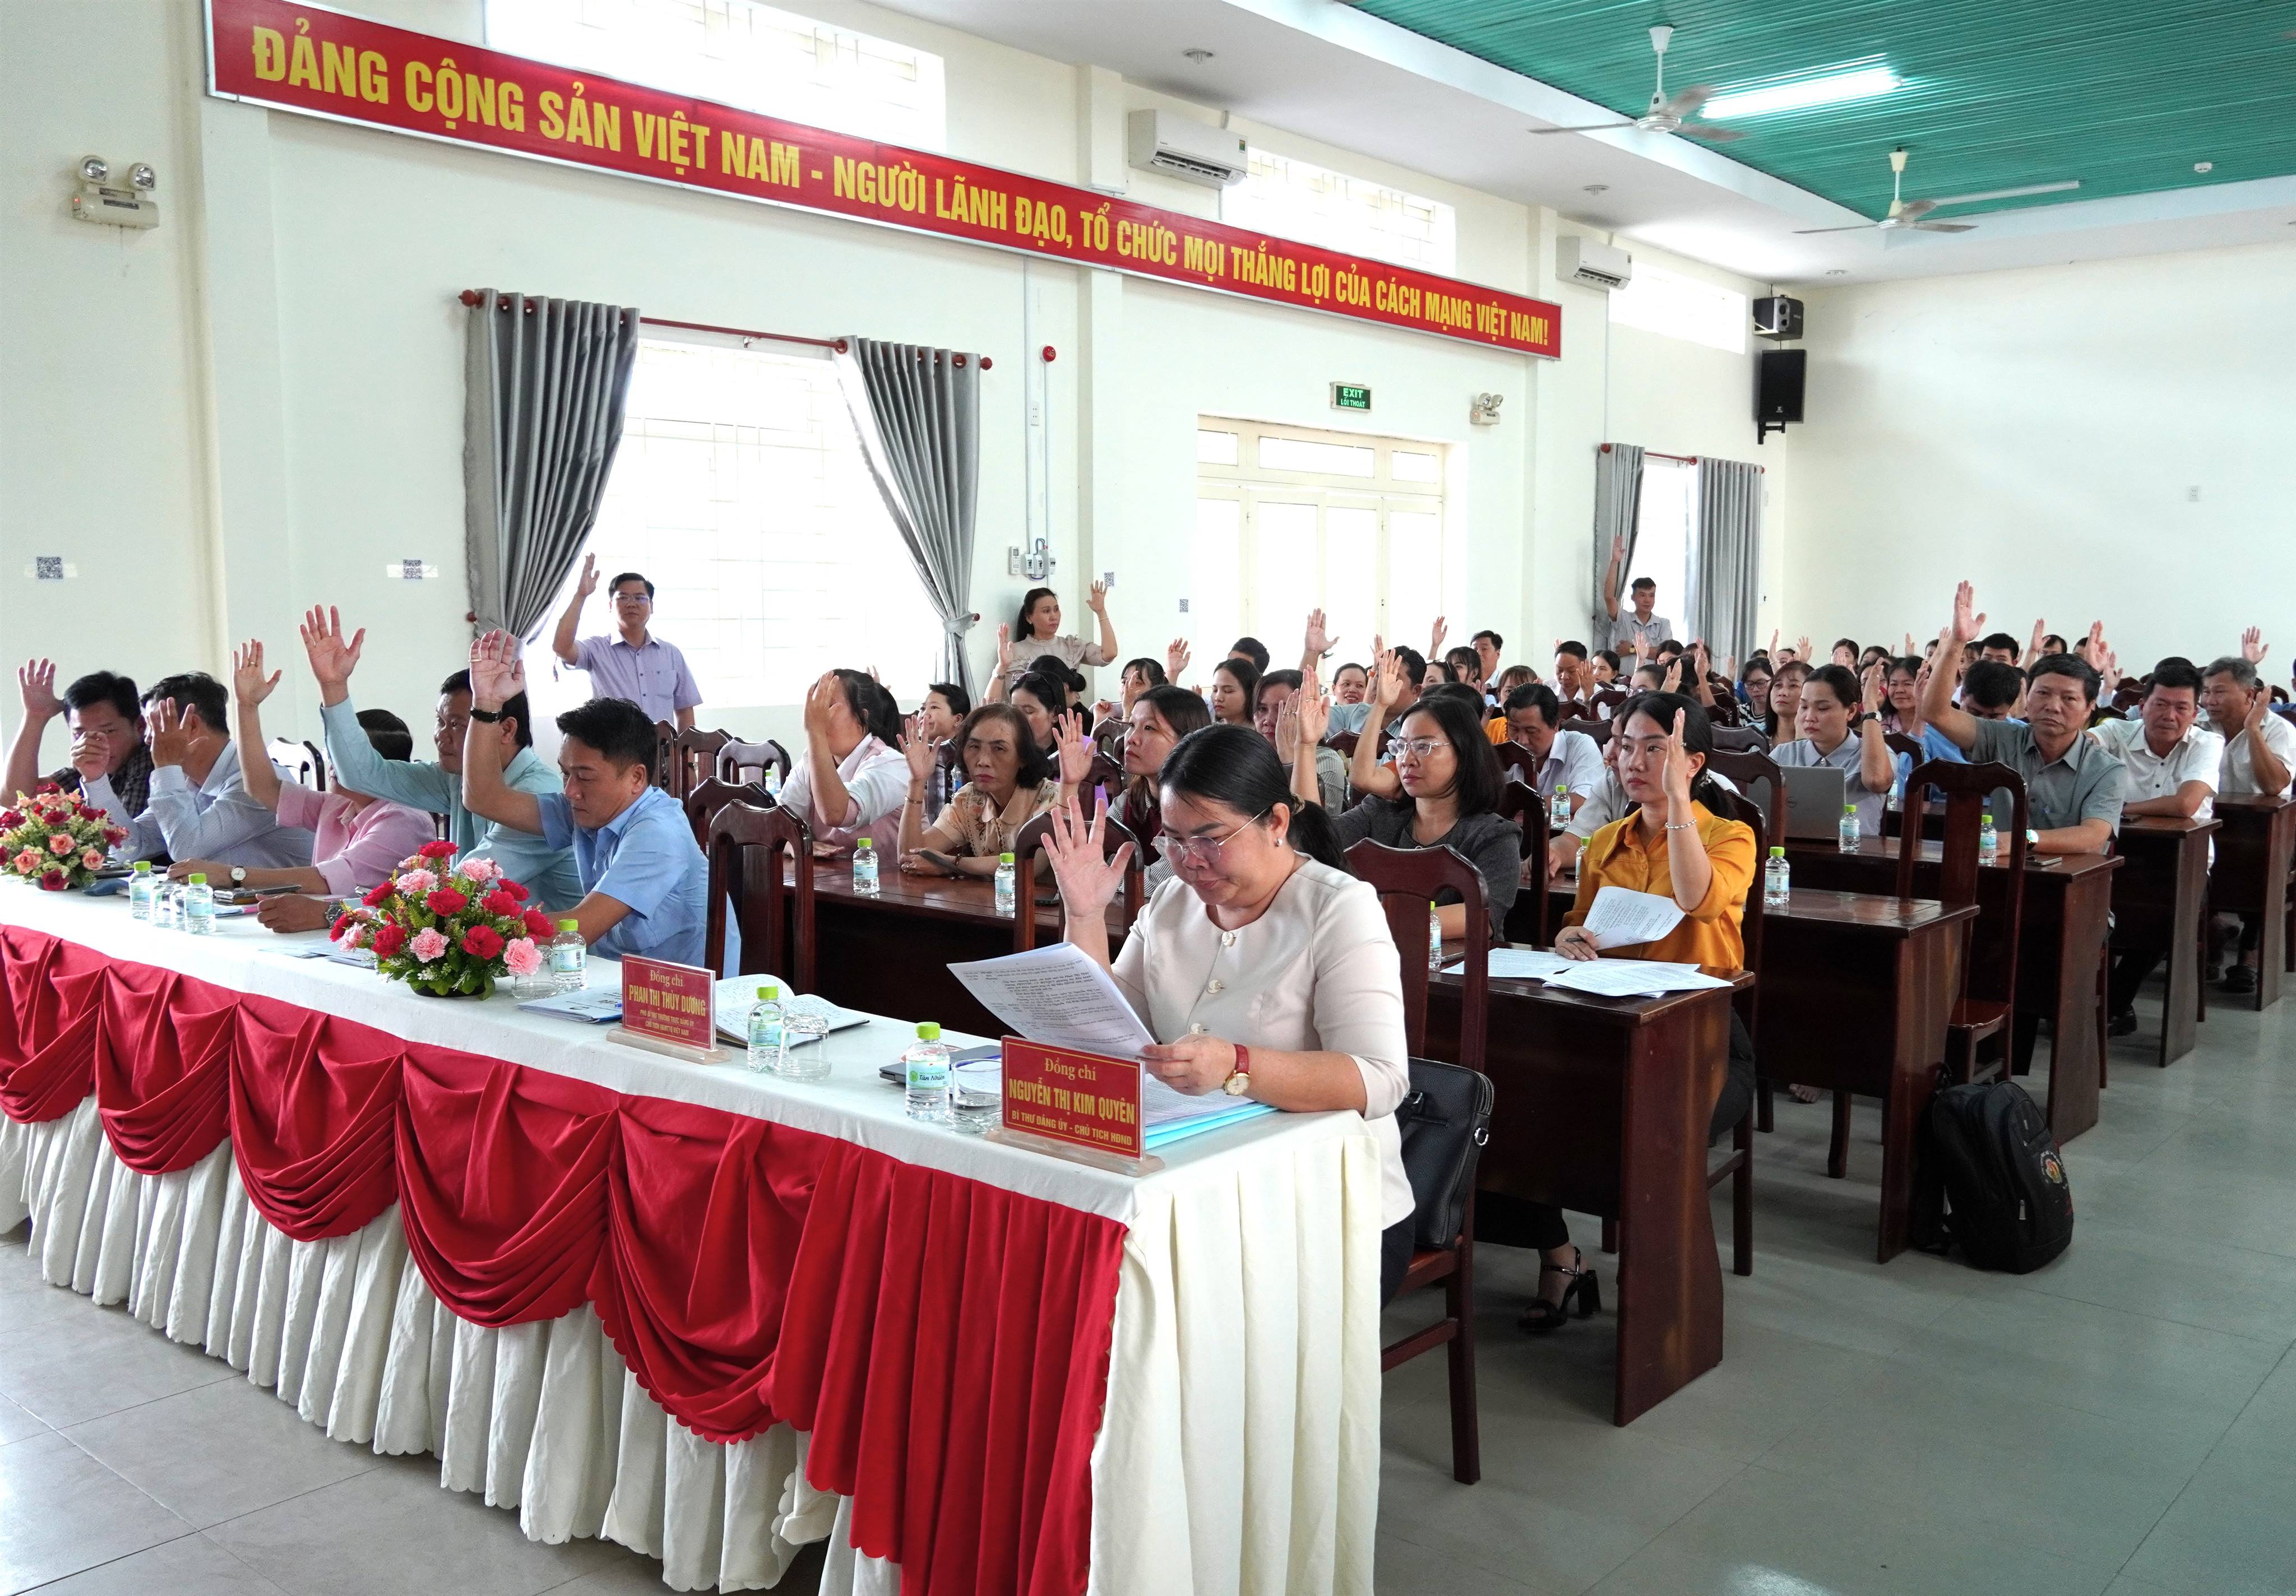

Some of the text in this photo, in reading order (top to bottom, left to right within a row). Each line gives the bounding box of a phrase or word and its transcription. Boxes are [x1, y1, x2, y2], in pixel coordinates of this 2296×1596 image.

[253, 18, 1548, 346] ĐẢNG CỘNG SẢN VIỆT NAM - NGƯỜI LÃNH ĐẠO, TỔ CHỨC MỌI THẮNG LỢI CỦA CÁCH MẠNG VIỆT NAM!
[1343, 387, 1363, 399] EXIT
[1350, 400, 1365, 408] THOÁT
[650, 969, 683, 987] Đồng chí
[629, 985, 648, 1004] PHAN
[649, 988, 660, 1010] THỊ
[681, 995, 706, 1017] DƯƠNG
[1044, 1057, 1096, 1081] Đồng chí
[1009, 1077, 1051, 1107] NGUYỄN
[1053, 1087, 1071, 1116] THỊ
[1073, 1091, 1095, 1116] KIM
[1099, 1097, 1135, 1125] QUYÊN
[1012, 1109, 1019, 1120] BÍ
[1021, 1112, 1036, 1124] THƯ
[1036, 1114, 1056, 1129] ĐẢNG
[1058, 1117, 1067, 1131] ỦY
[1074, 1123, 1090, 1136] CHỦ
[1091, 1128, 1109, 1141] TỊCH
